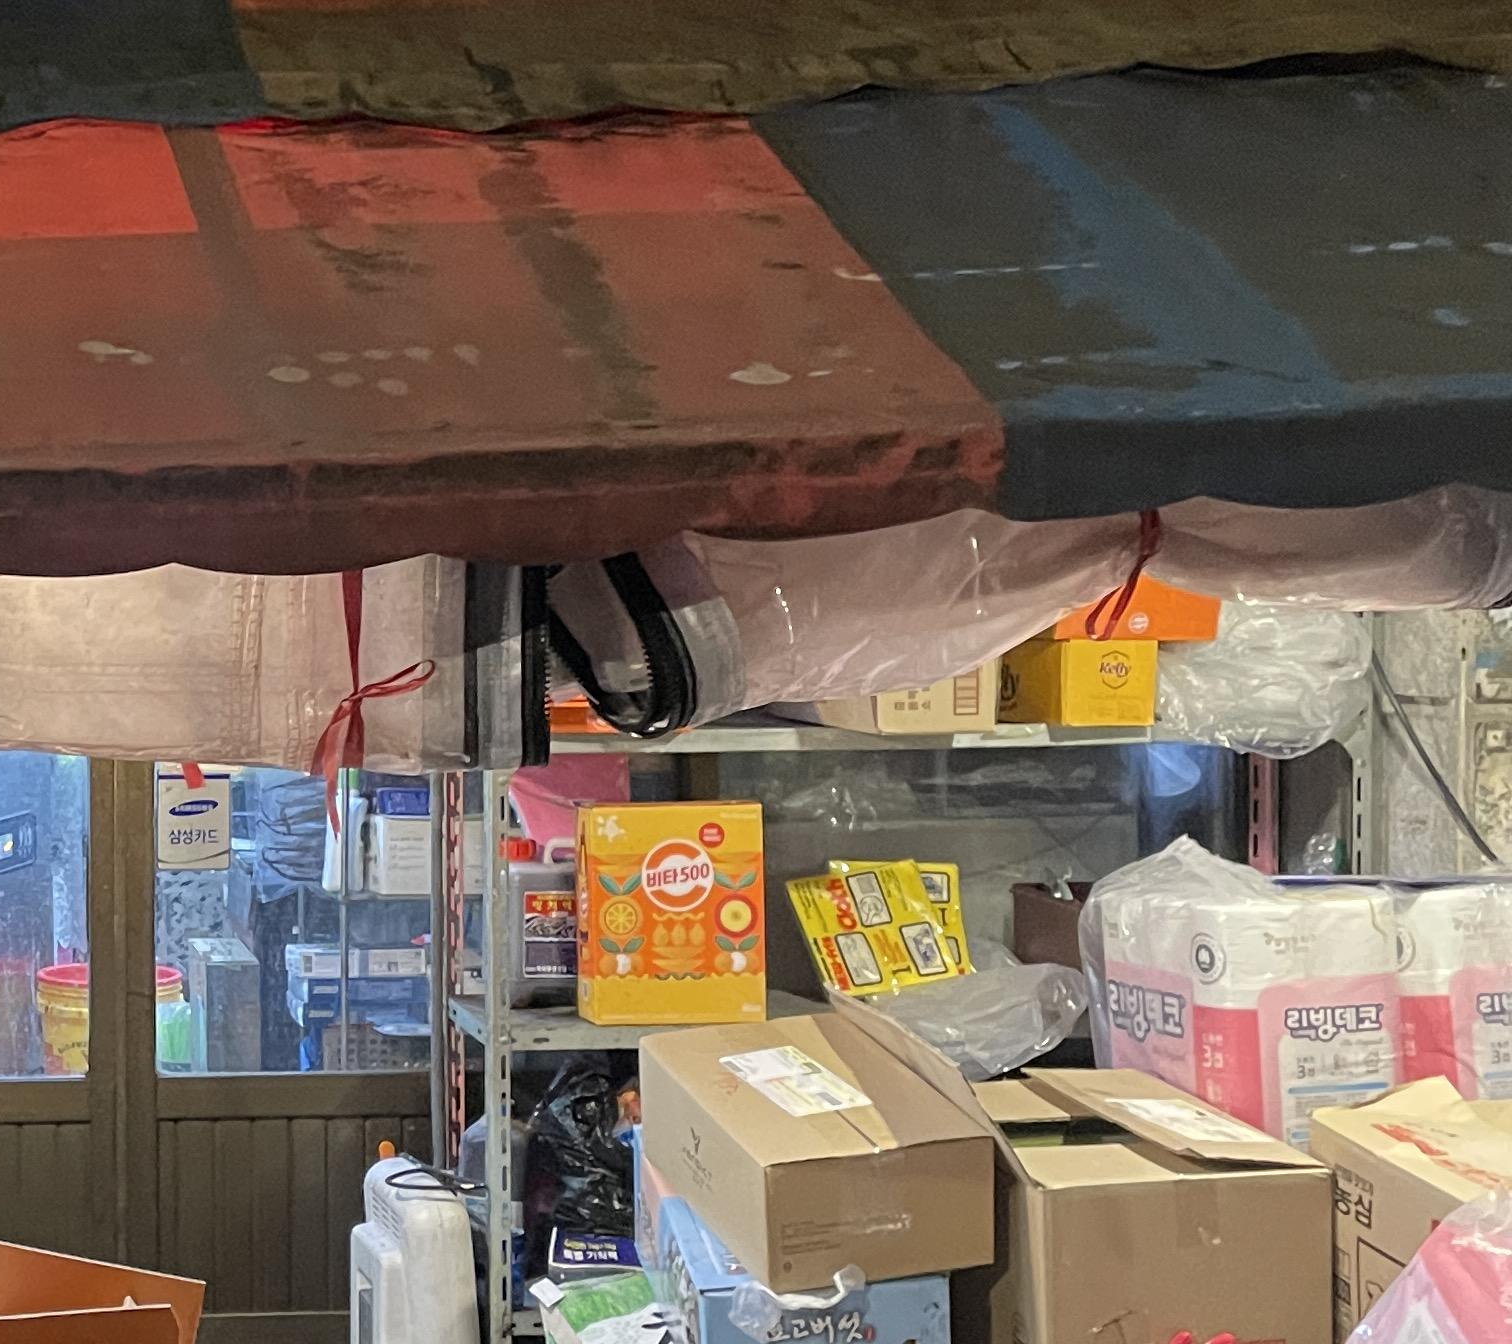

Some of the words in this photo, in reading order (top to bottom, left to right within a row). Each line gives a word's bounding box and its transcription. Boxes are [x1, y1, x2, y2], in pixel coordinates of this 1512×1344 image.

[168, 828, 220, 846] 삼성카드
[646, 862, 711, 889] 비타500
[1108, 979, 1186, 1043] 리빙데코
[1284, 1003, 1384, 1044] 리빙데코
